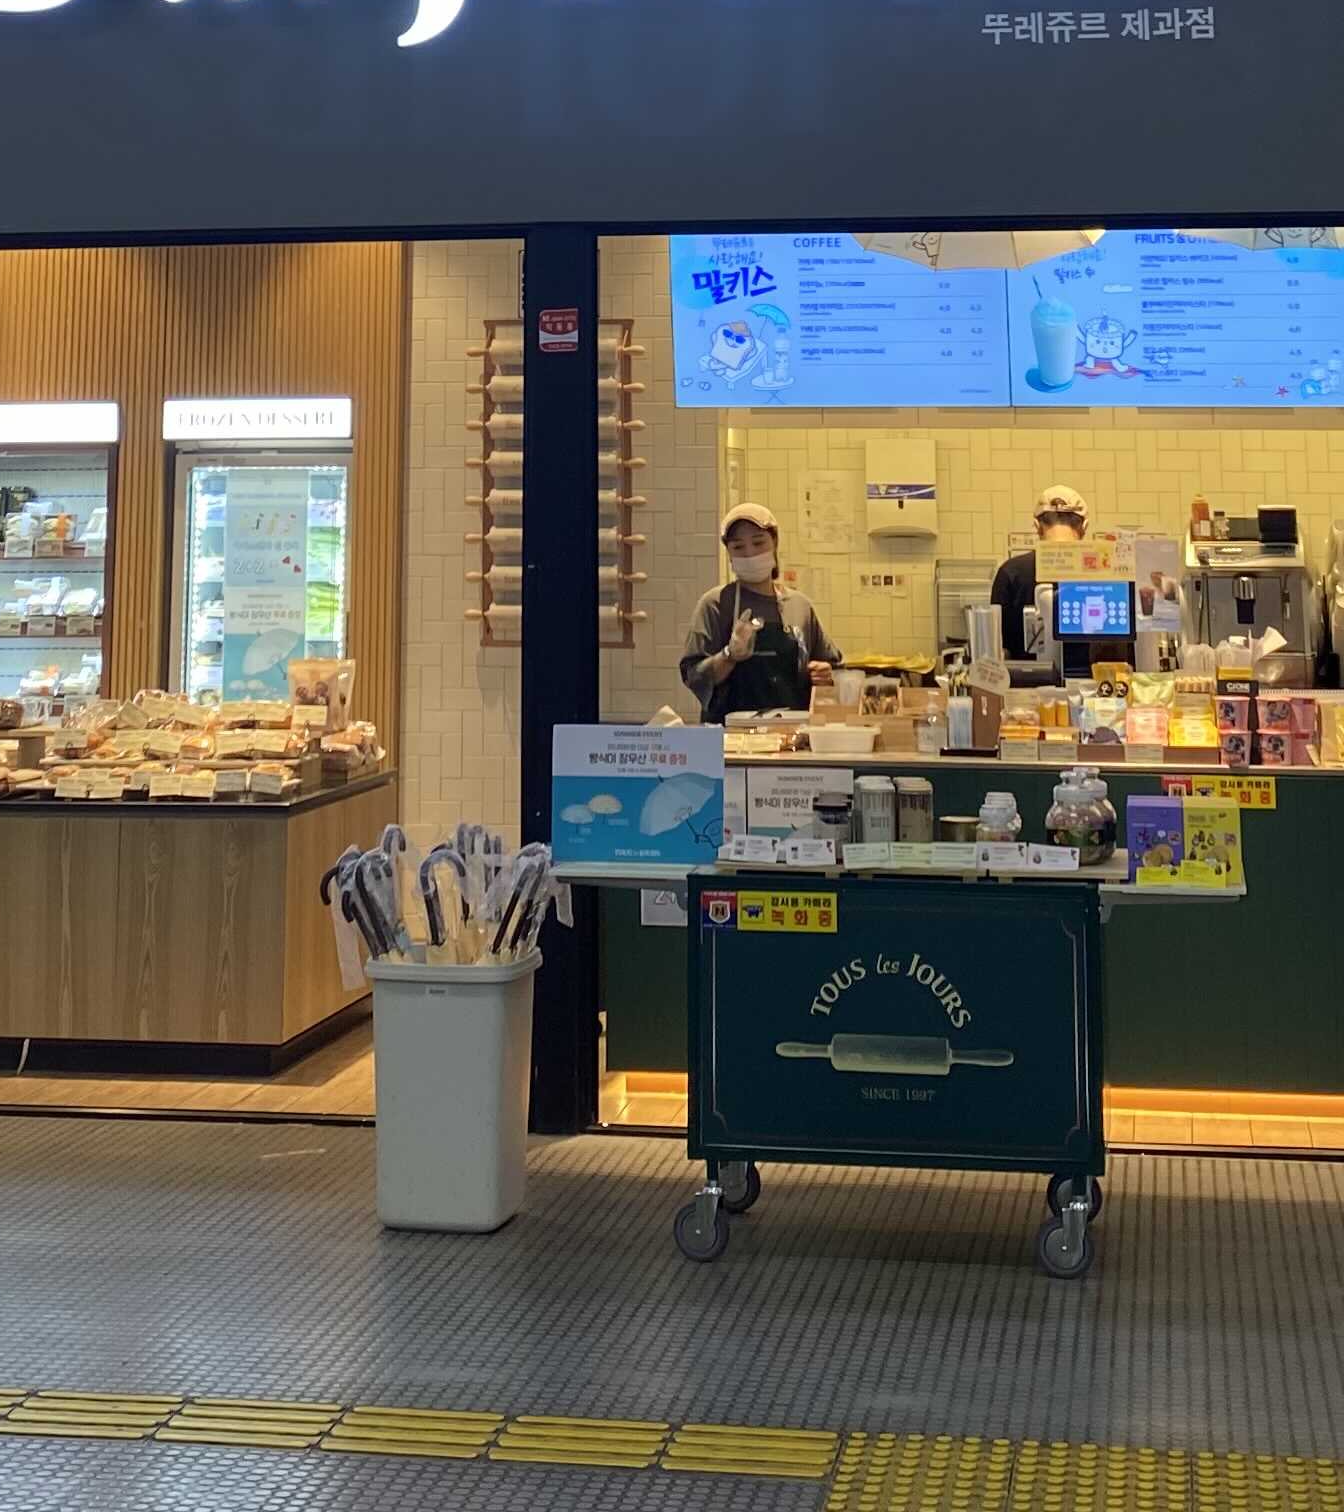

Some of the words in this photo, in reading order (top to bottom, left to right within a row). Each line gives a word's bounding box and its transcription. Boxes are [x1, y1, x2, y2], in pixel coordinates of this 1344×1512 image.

[981, 11, 1110, 45] 뚜레쥬르
[1120, 6, 1215, 41] 제과점
[793, 237, 841, 248] COFFEE
[1135, 233, 1174, 244] FRUITS
[692, 265, 778, 305] 밀키스
[803, 896, 832, 908] 카메라
[810, 958, 866, 1016] TOUS
[876, 953, 900, 974] les
[906, 953, 972, 1029] JOURS
[861, 1088, 899, 1101] SINCE
[905, 1088, 936, 1102] 1997
